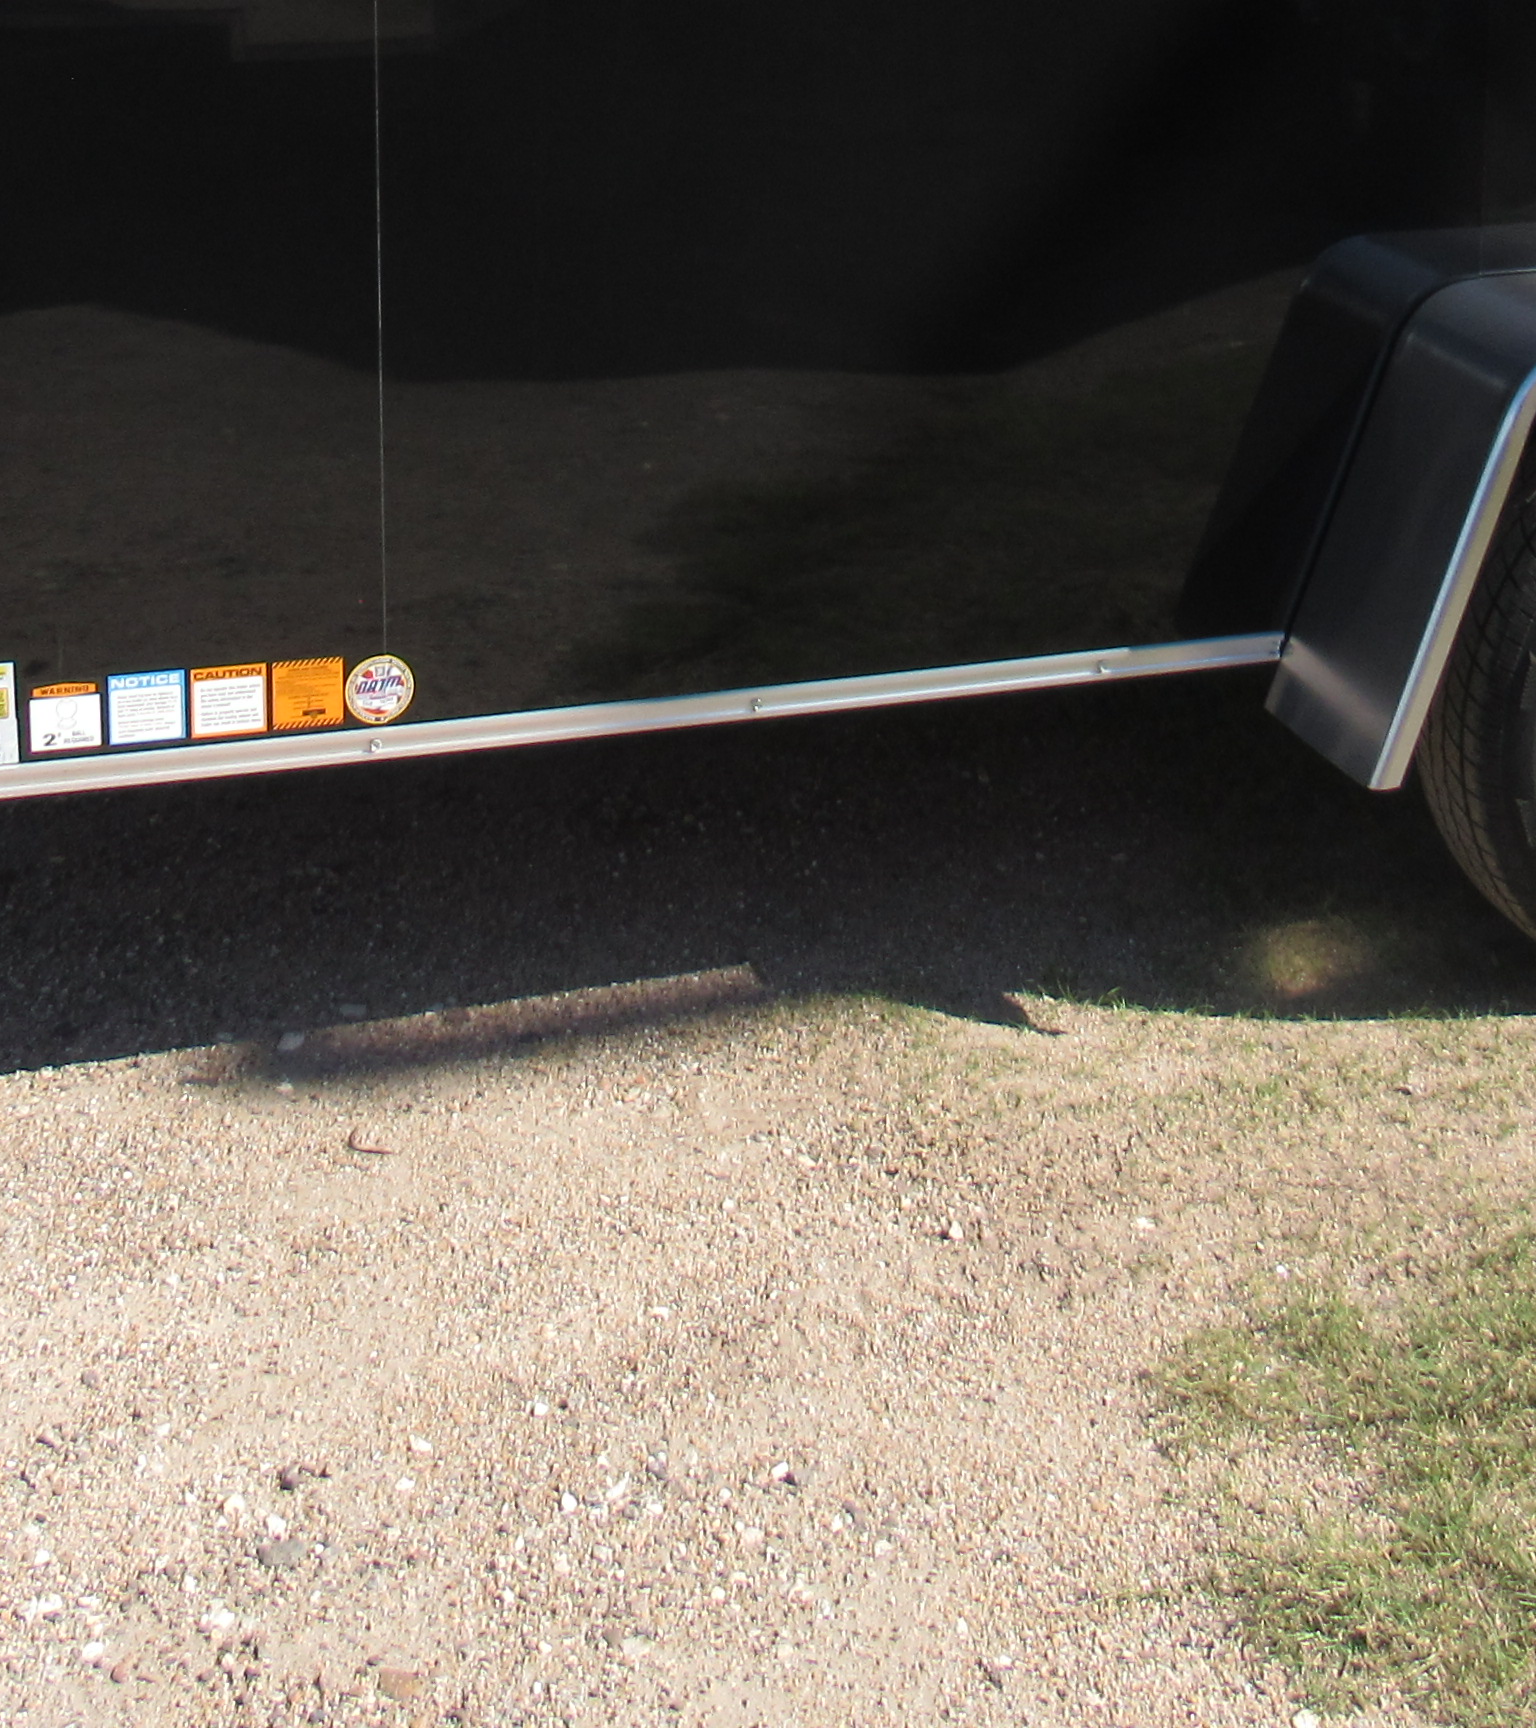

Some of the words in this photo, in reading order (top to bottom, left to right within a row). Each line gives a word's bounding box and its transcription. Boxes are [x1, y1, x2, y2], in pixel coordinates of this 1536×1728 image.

[110, 672, 181, 689] NOTICE
[193, 666, 263, 682] CAUTION
[40, 684, 89, 695] WARNING
